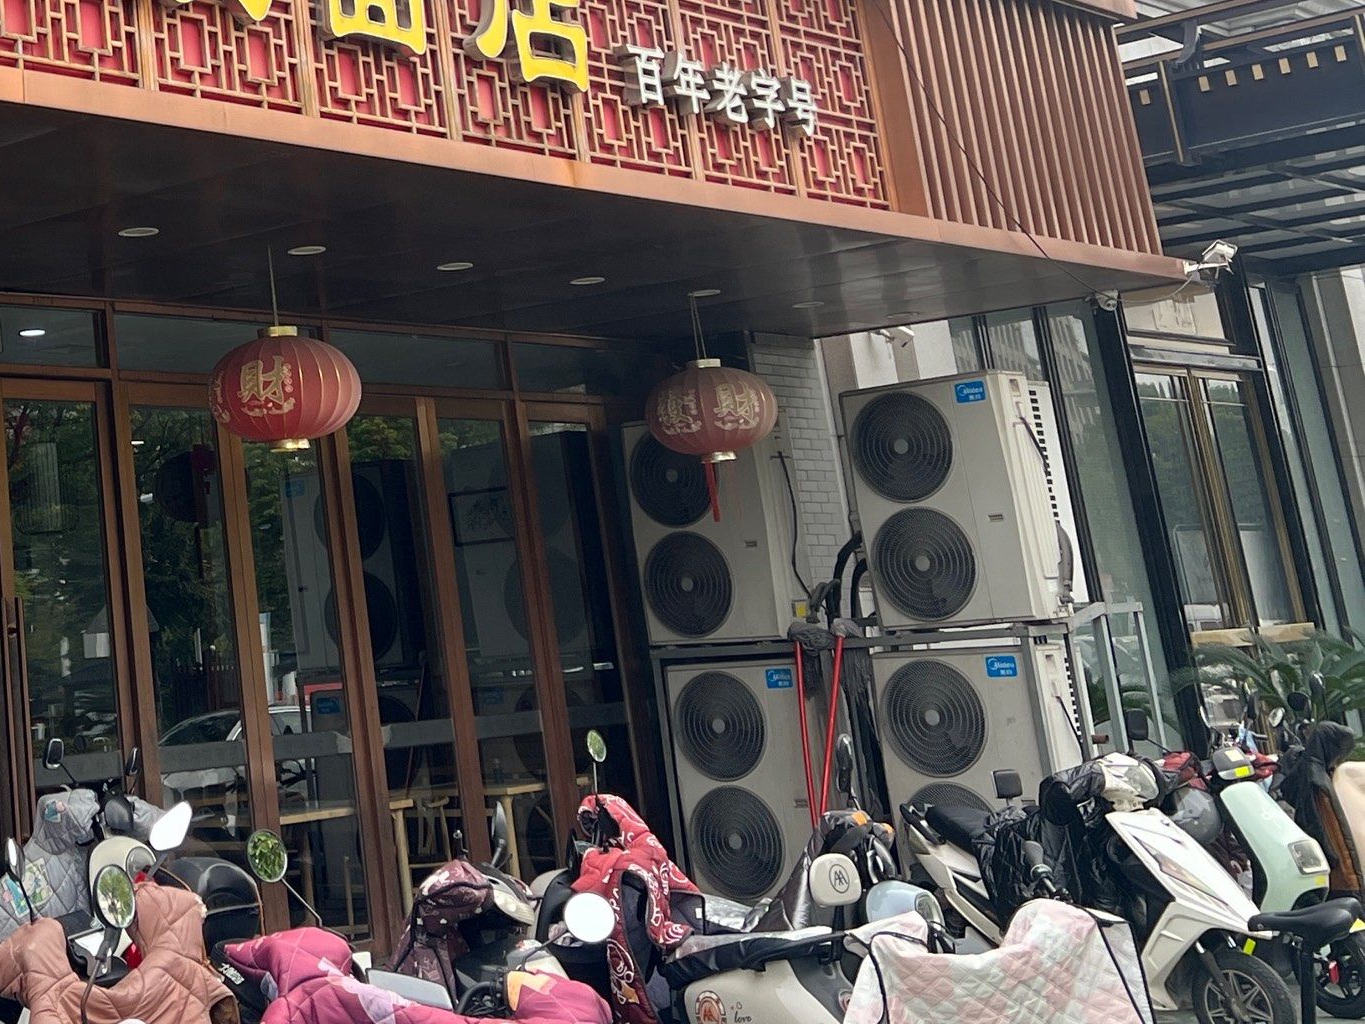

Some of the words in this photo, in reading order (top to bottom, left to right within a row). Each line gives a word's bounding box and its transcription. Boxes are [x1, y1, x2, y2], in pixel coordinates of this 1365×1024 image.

[620, 43, 817, 137] 百年老字号
